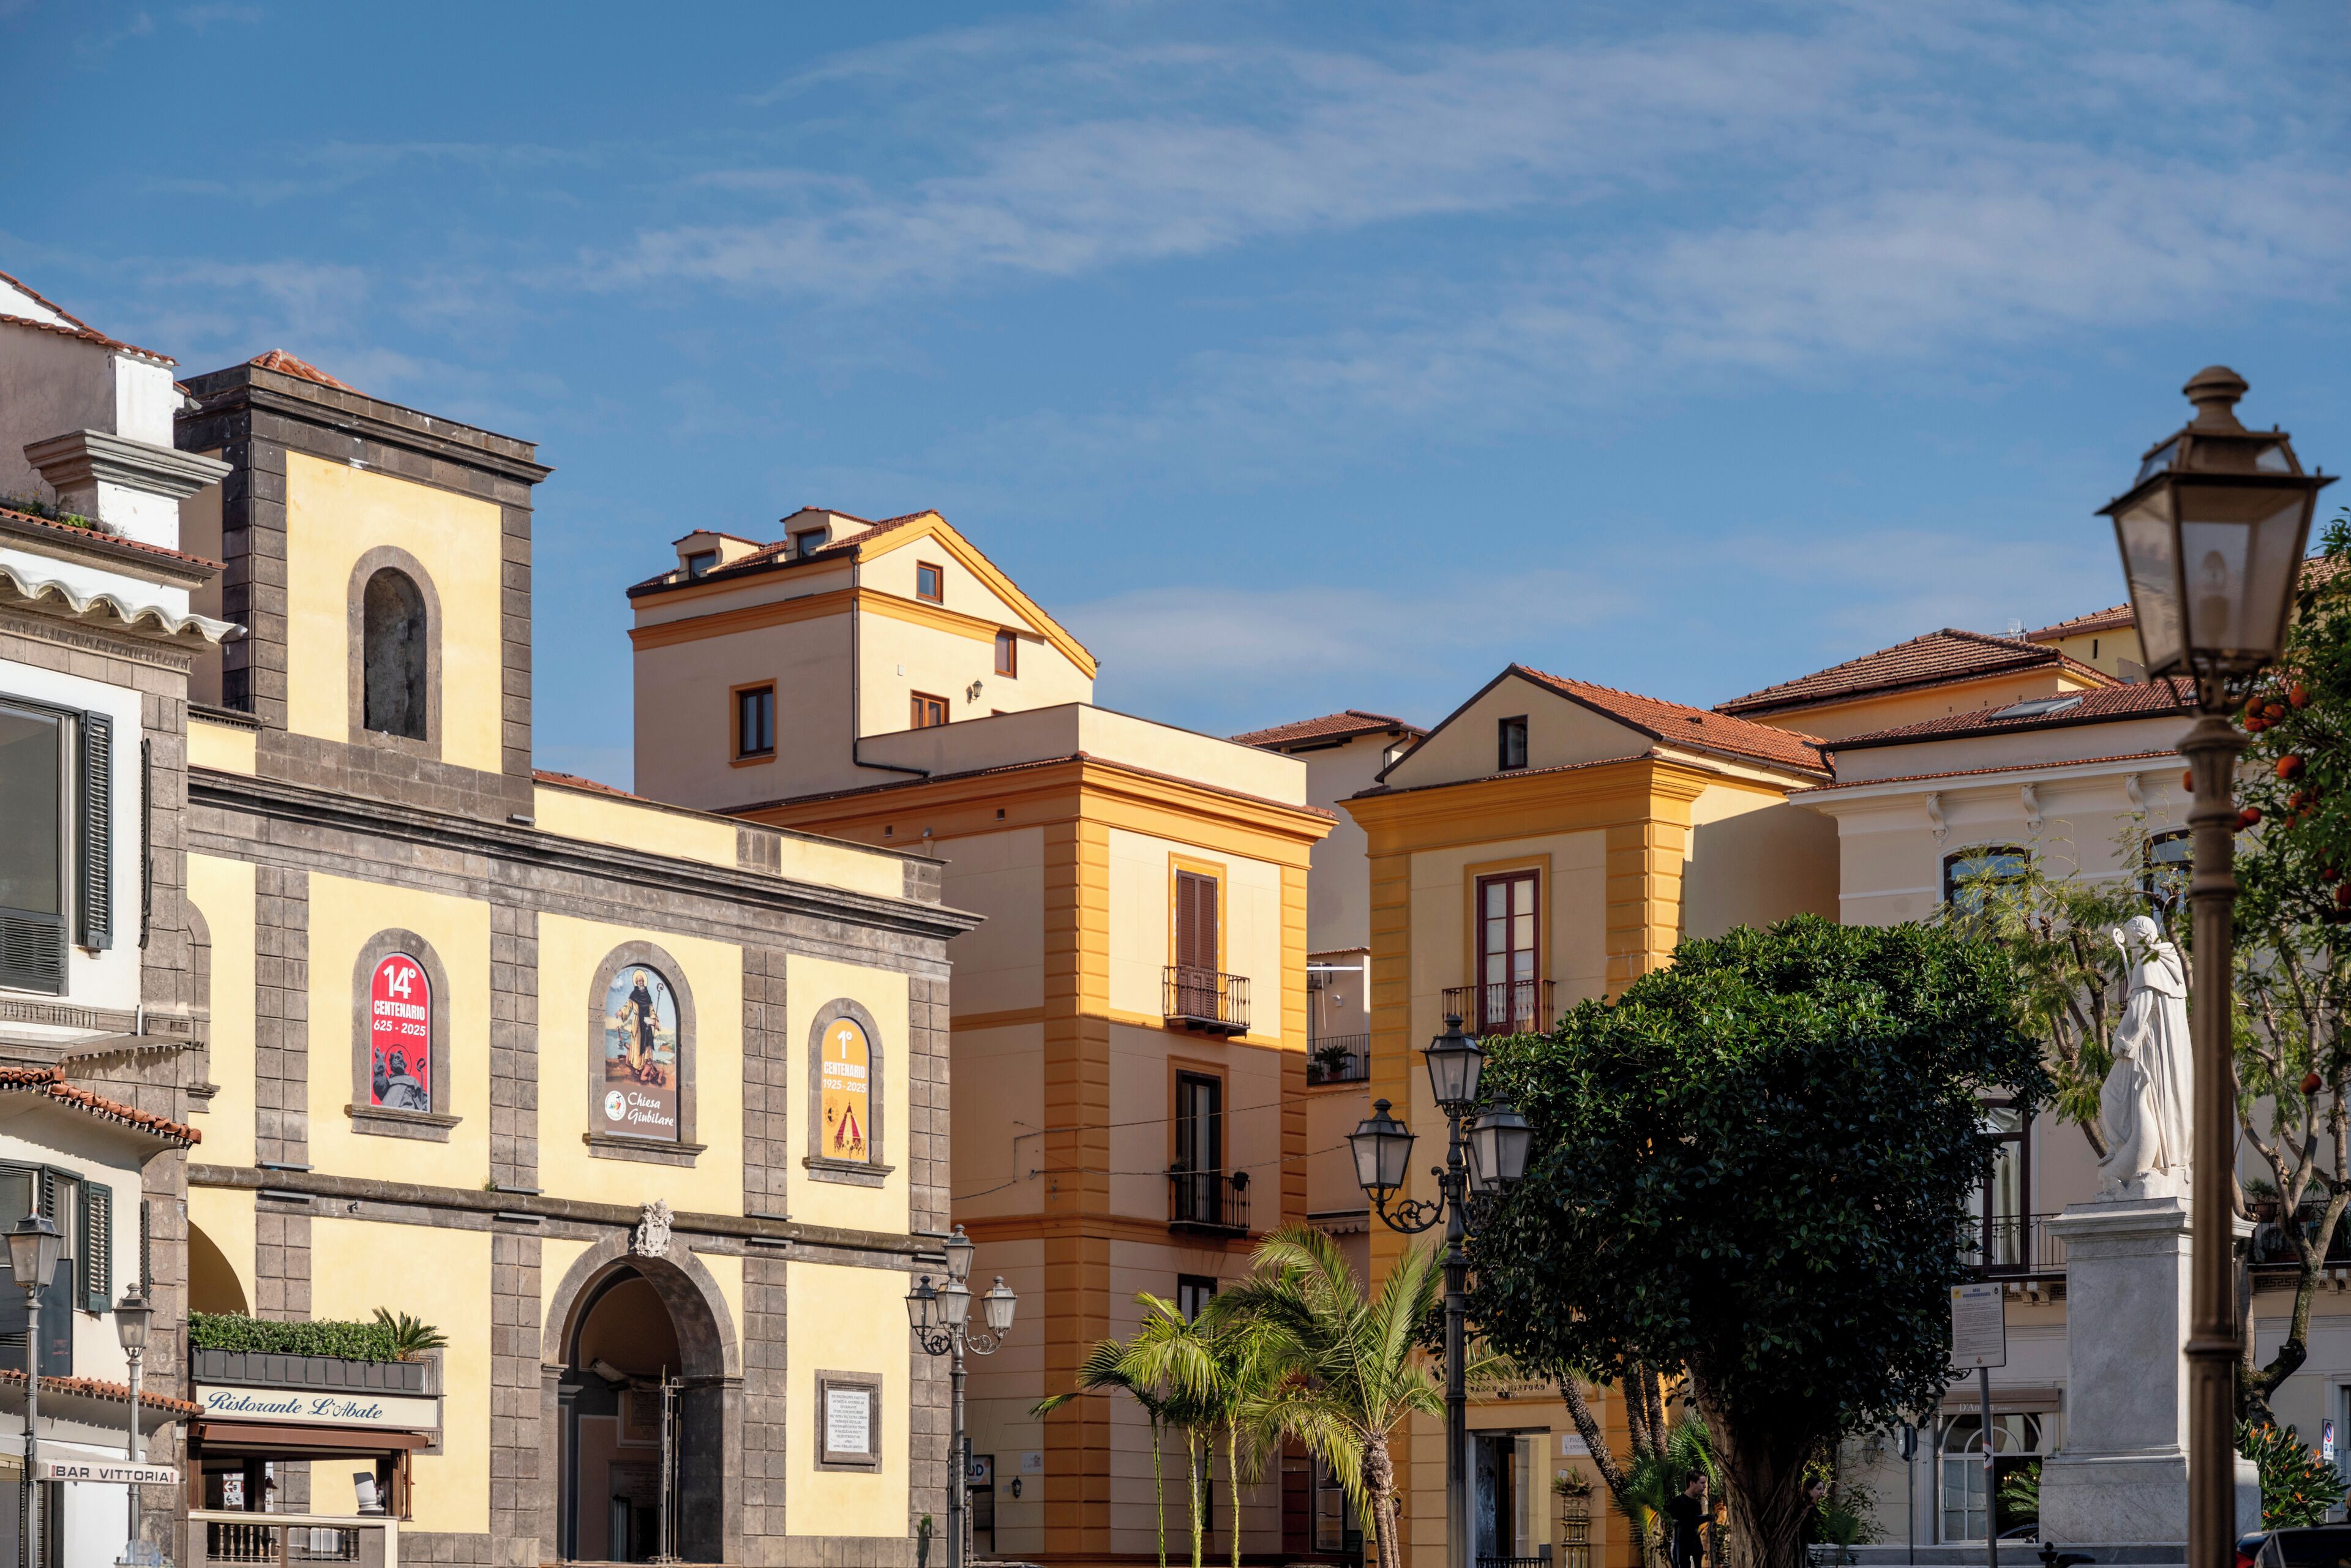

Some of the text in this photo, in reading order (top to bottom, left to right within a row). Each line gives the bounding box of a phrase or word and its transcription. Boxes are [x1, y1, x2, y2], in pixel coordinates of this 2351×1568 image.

[373, 1000, 426, 1021] CENTENARIO
[373, 1019, 393, 1032] 625
[401, 1022, 426, 1037] 2025
[823, 1060, 865, 1079] CENTENARIO
[627, 1092, 661, 1109] Chiesa
[627, 1108, 674, 1127] Giubilare
[203, 1391, 383, 1419] Ristorante L'Abate
[1959, 1402, 1994, 1412] D'Ann
[56, 1466, 169, 1482] BAR VITTORIA
